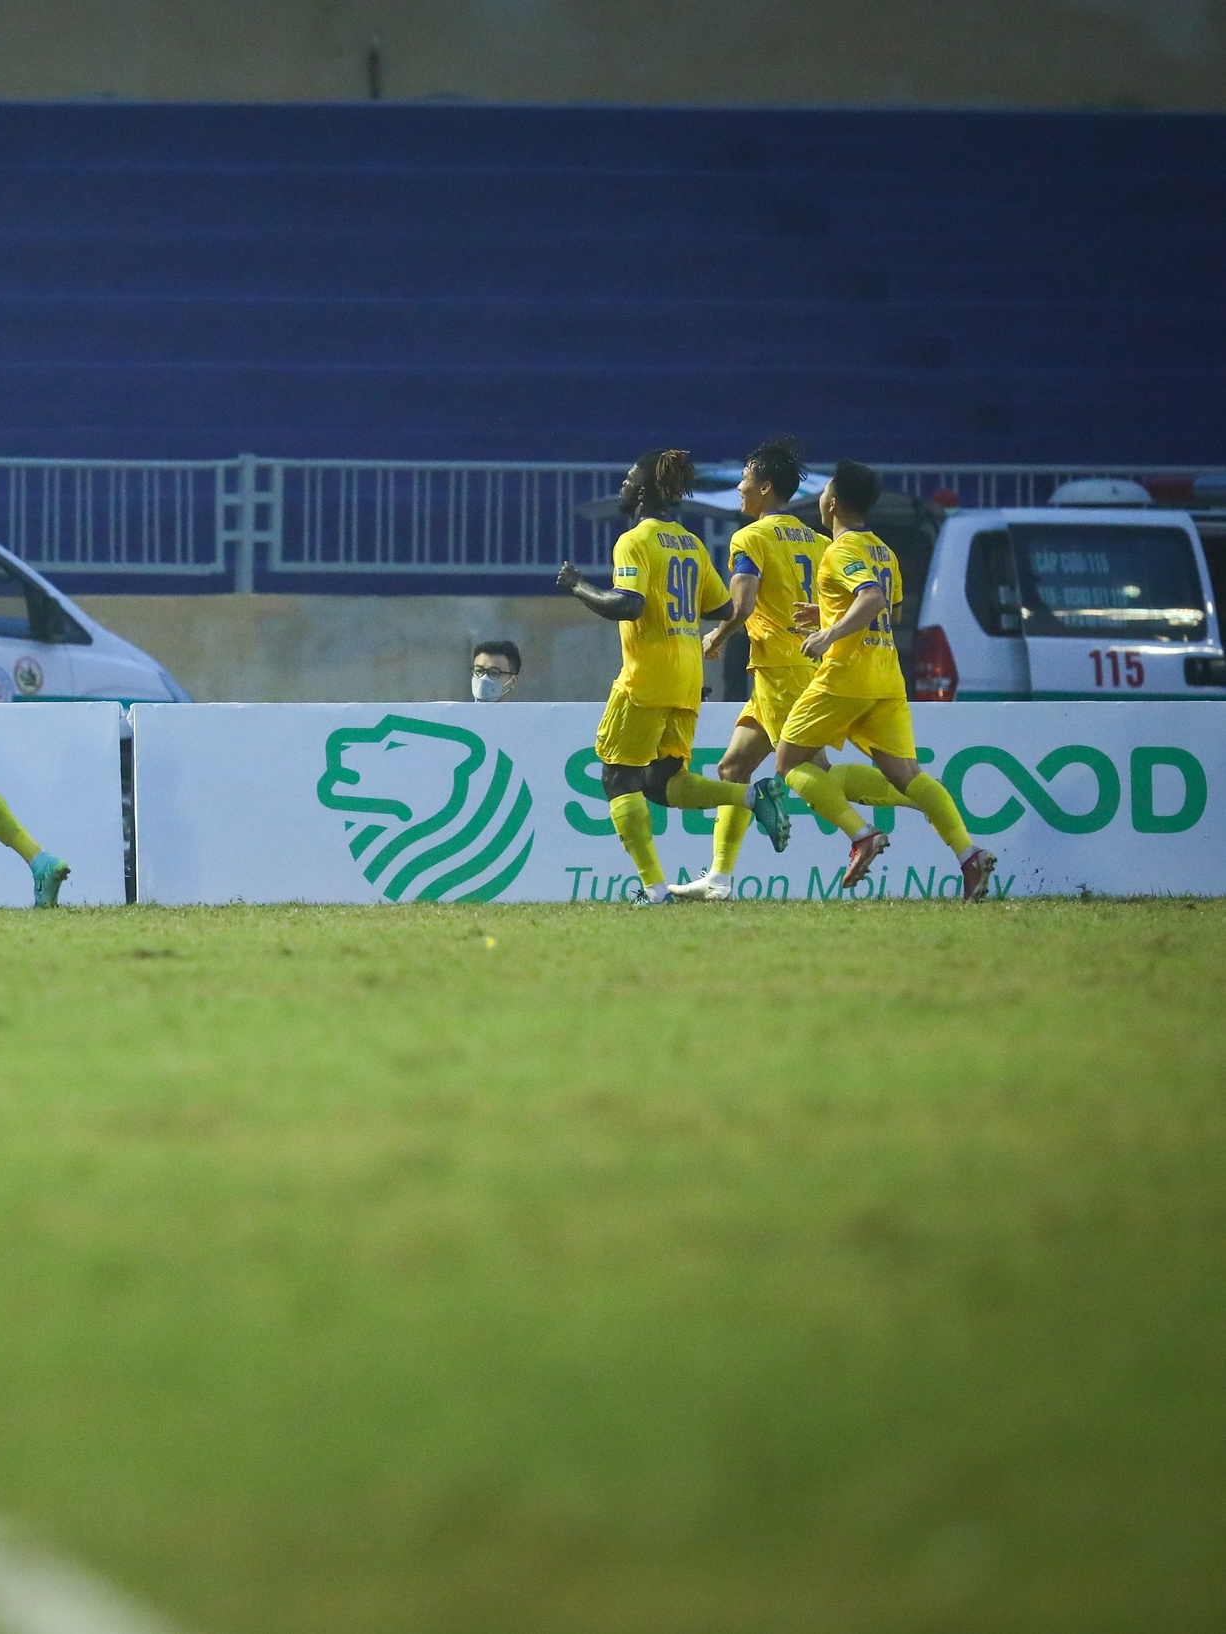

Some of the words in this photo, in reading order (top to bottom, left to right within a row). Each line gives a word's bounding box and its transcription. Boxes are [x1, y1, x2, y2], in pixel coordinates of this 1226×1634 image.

[667, 556, 699, 623] 90
[1089, 649, 1145, 687] 115
[677, 866, 790, 900] Non
